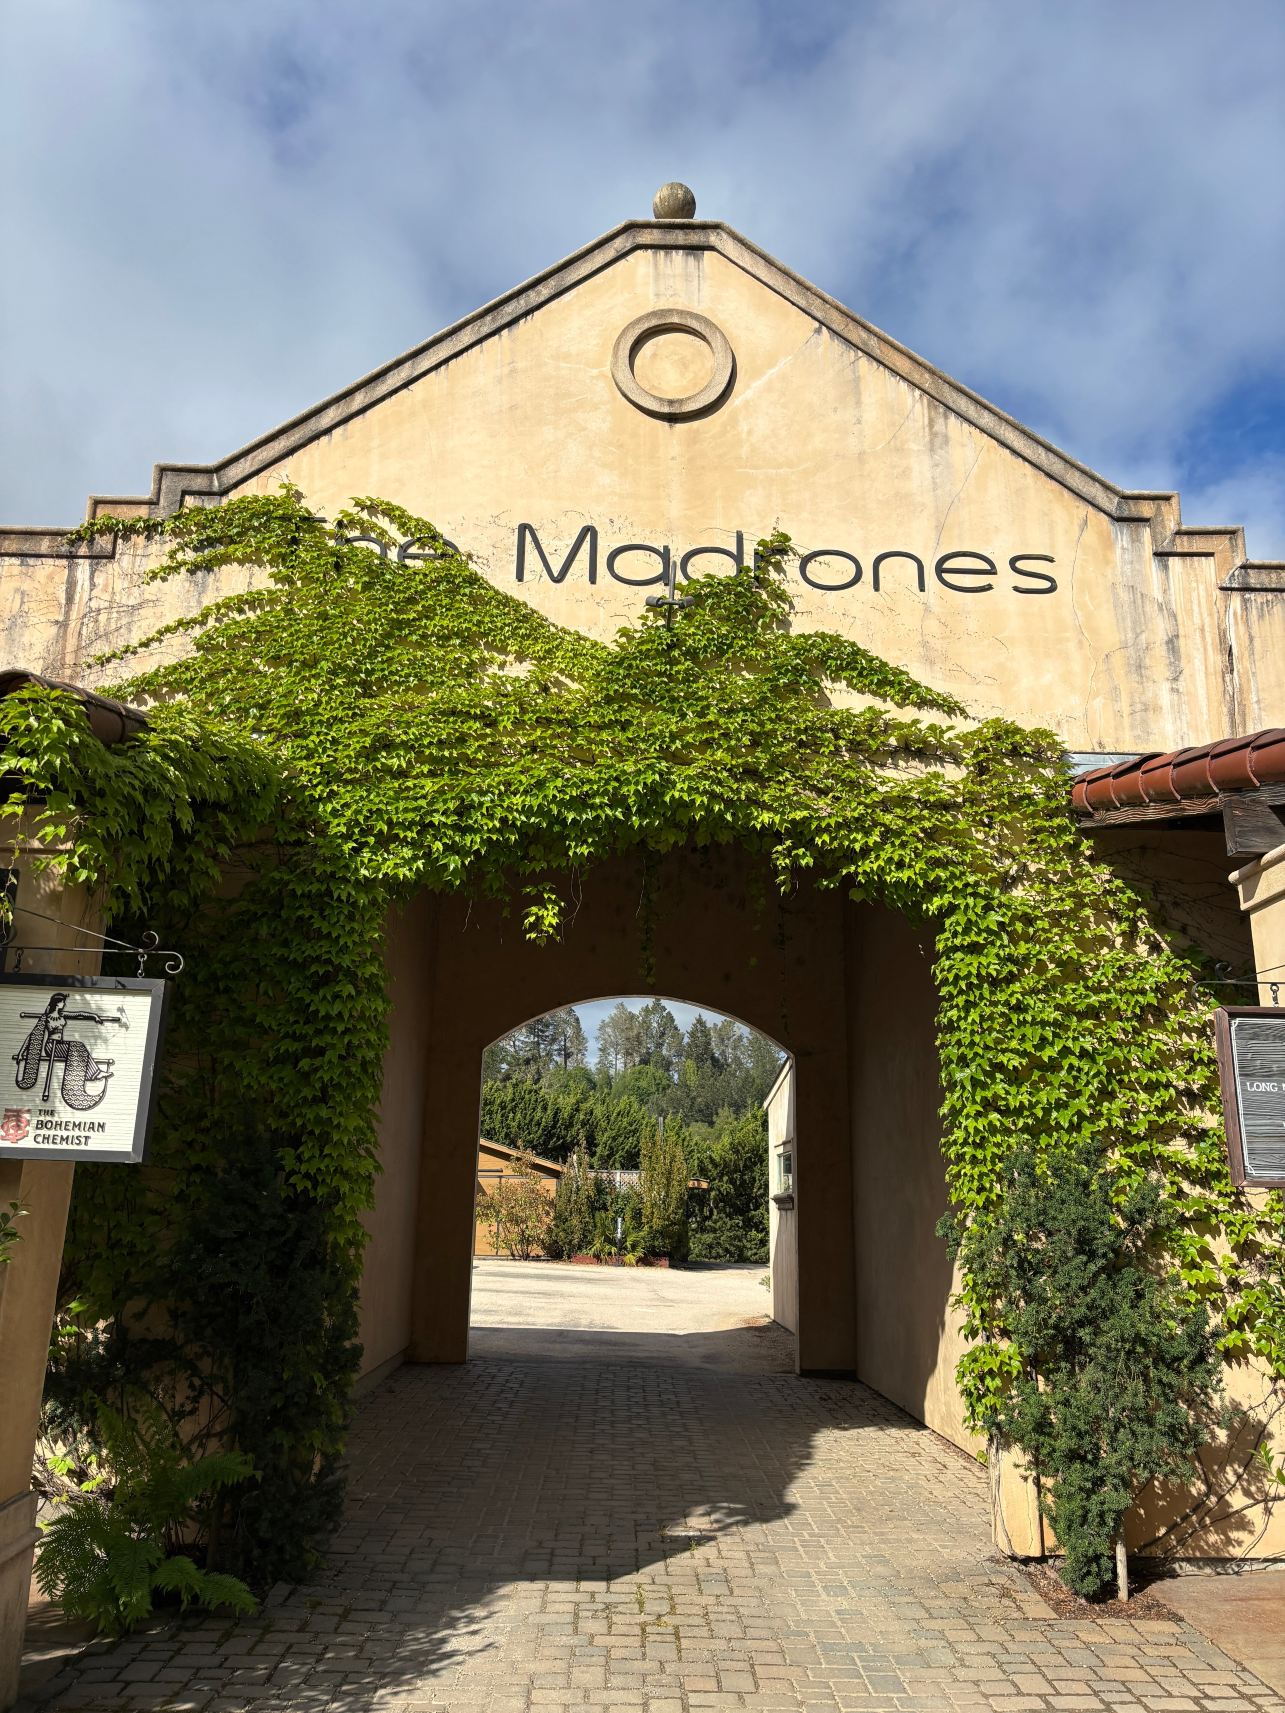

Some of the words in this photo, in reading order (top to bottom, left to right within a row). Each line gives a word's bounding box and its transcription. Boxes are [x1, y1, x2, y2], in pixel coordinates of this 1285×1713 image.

[515, 522, 1058, 595] Madrones
[1246, 1082, 1279, 1092] LONG
[38, 1108, 56, 1117] THE
[35, 1119, 106, 1133] BOHEMIAN
[33, 1133, 91, 1146] CHEMIST
